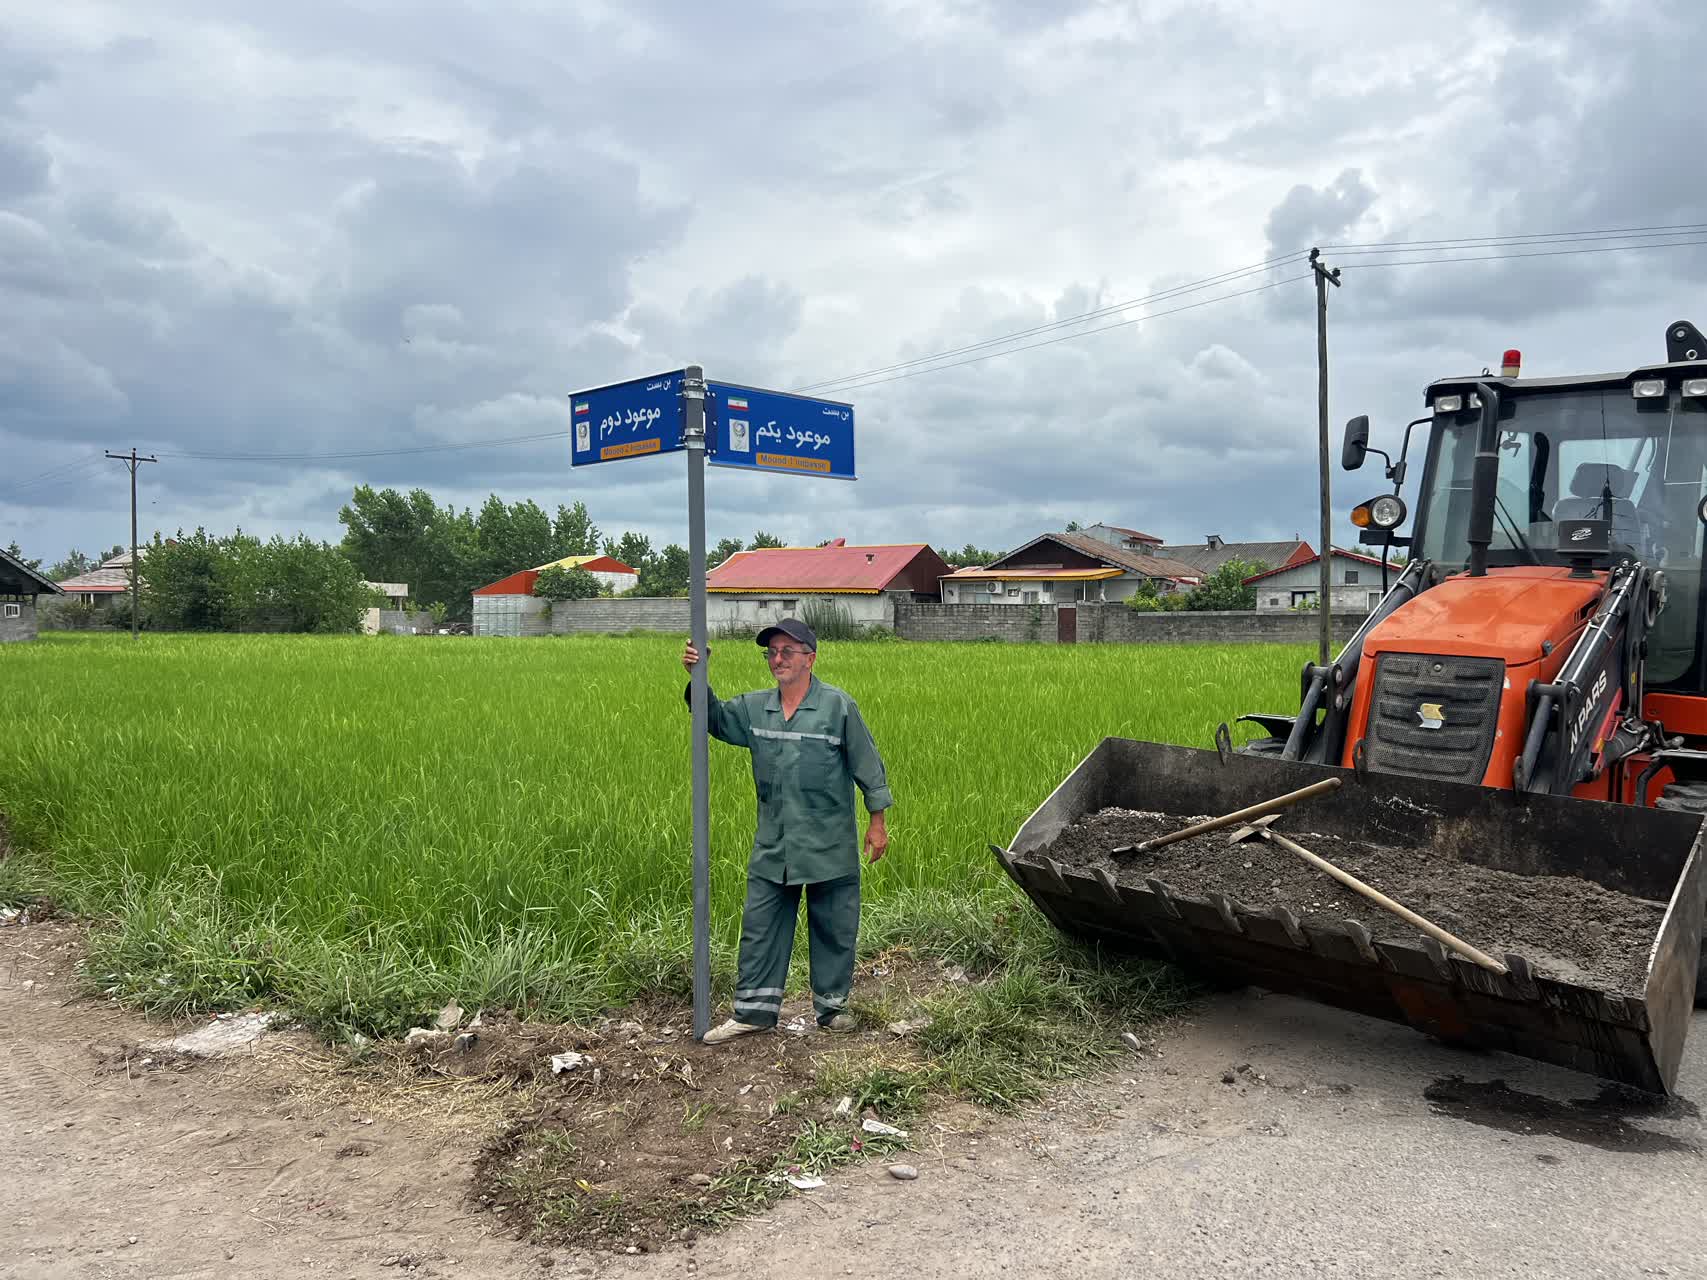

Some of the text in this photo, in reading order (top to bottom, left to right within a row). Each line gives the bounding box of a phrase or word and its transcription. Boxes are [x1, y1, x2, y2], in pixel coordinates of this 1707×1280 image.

[646, 379, 671, 391] بن بست
[600, 407, 661, 440] موعود دوم
[822, 407, 850, 421] بن بست
[755, 420, 831, 450] موعود یکم
[1578, 669, 1607, 733] PARS
